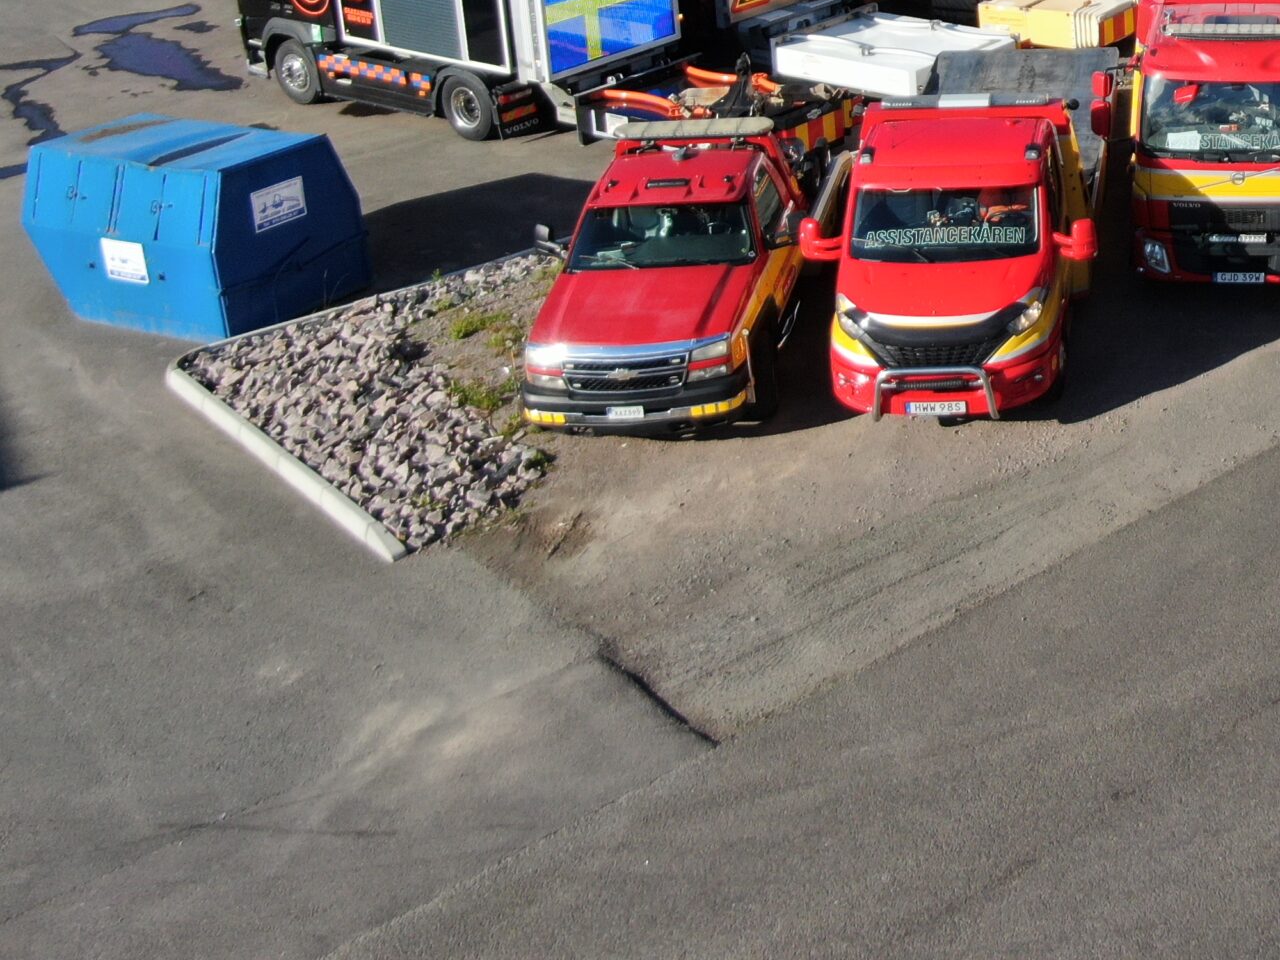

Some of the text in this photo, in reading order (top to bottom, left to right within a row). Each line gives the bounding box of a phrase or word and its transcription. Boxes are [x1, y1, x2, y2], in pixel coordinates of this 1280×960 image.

[504, 117, 540, 134] VOLVO
[865, 224, 1026, 247] ASSISTANCEKÅREN
[1220, 272, 1261, 282] GJD 39W
[914, 402, 961, 412] HWW 98S
